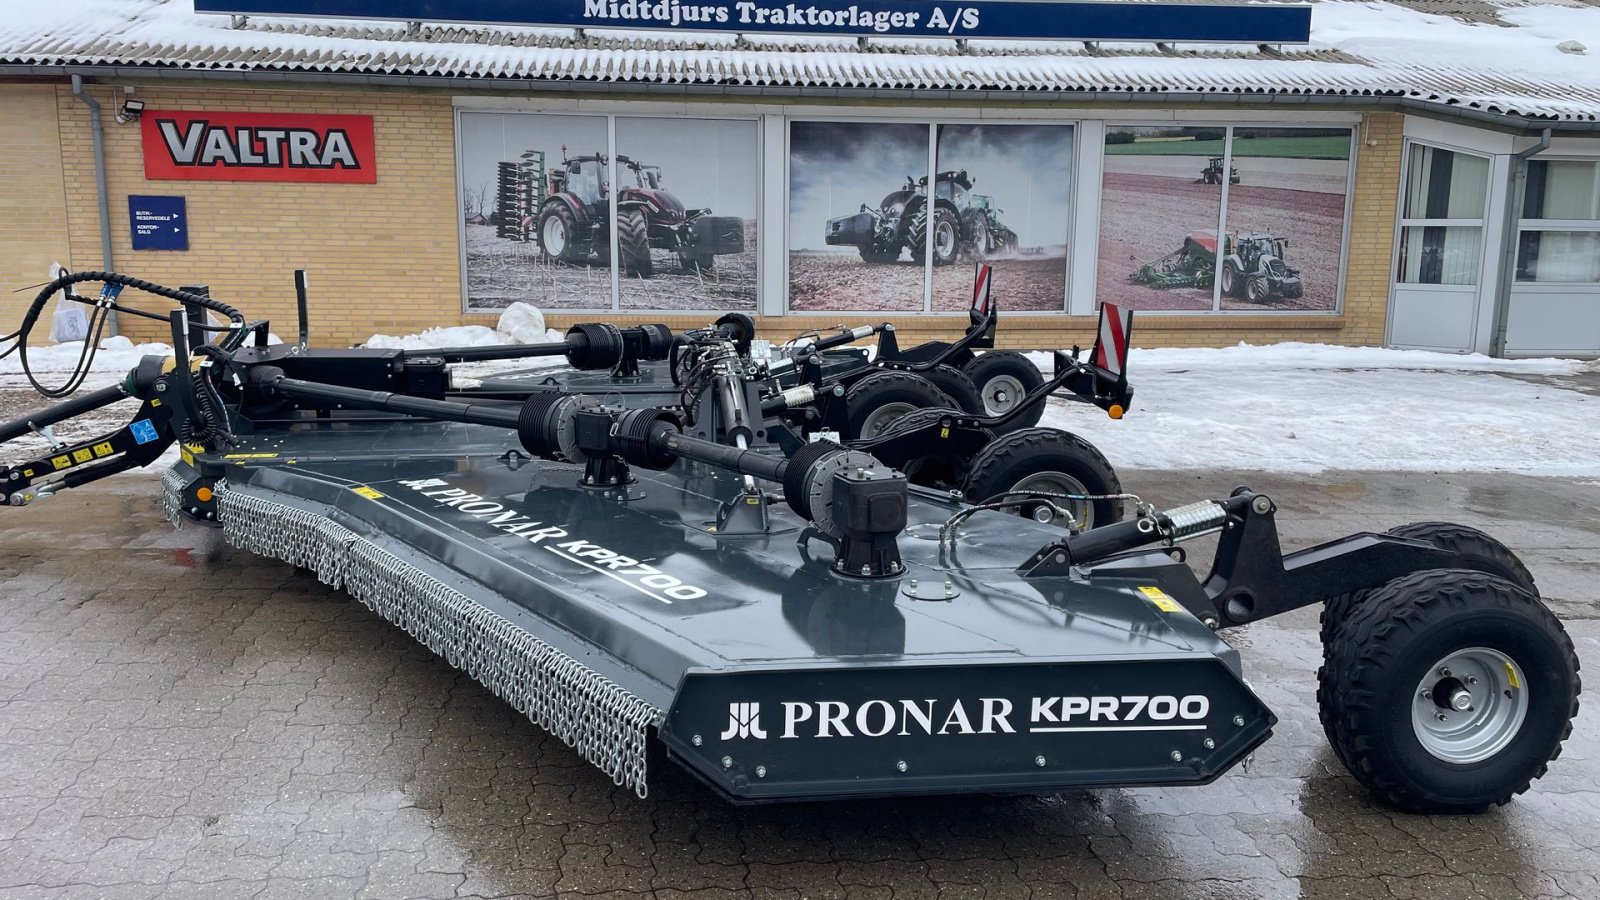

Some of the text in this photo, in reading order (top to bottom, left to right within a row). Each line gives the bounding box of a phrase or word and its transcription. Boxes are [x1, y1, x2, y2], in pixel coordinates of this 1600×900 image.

[583, 0, 980, 33] Midtdjurs Traktorlager A/S
[155, 119, 361, 169] VALTRA
[423, 487, 708, 600] PRONAR KPR700
[780, 695, 1210, 740] PRONAR KPR700
